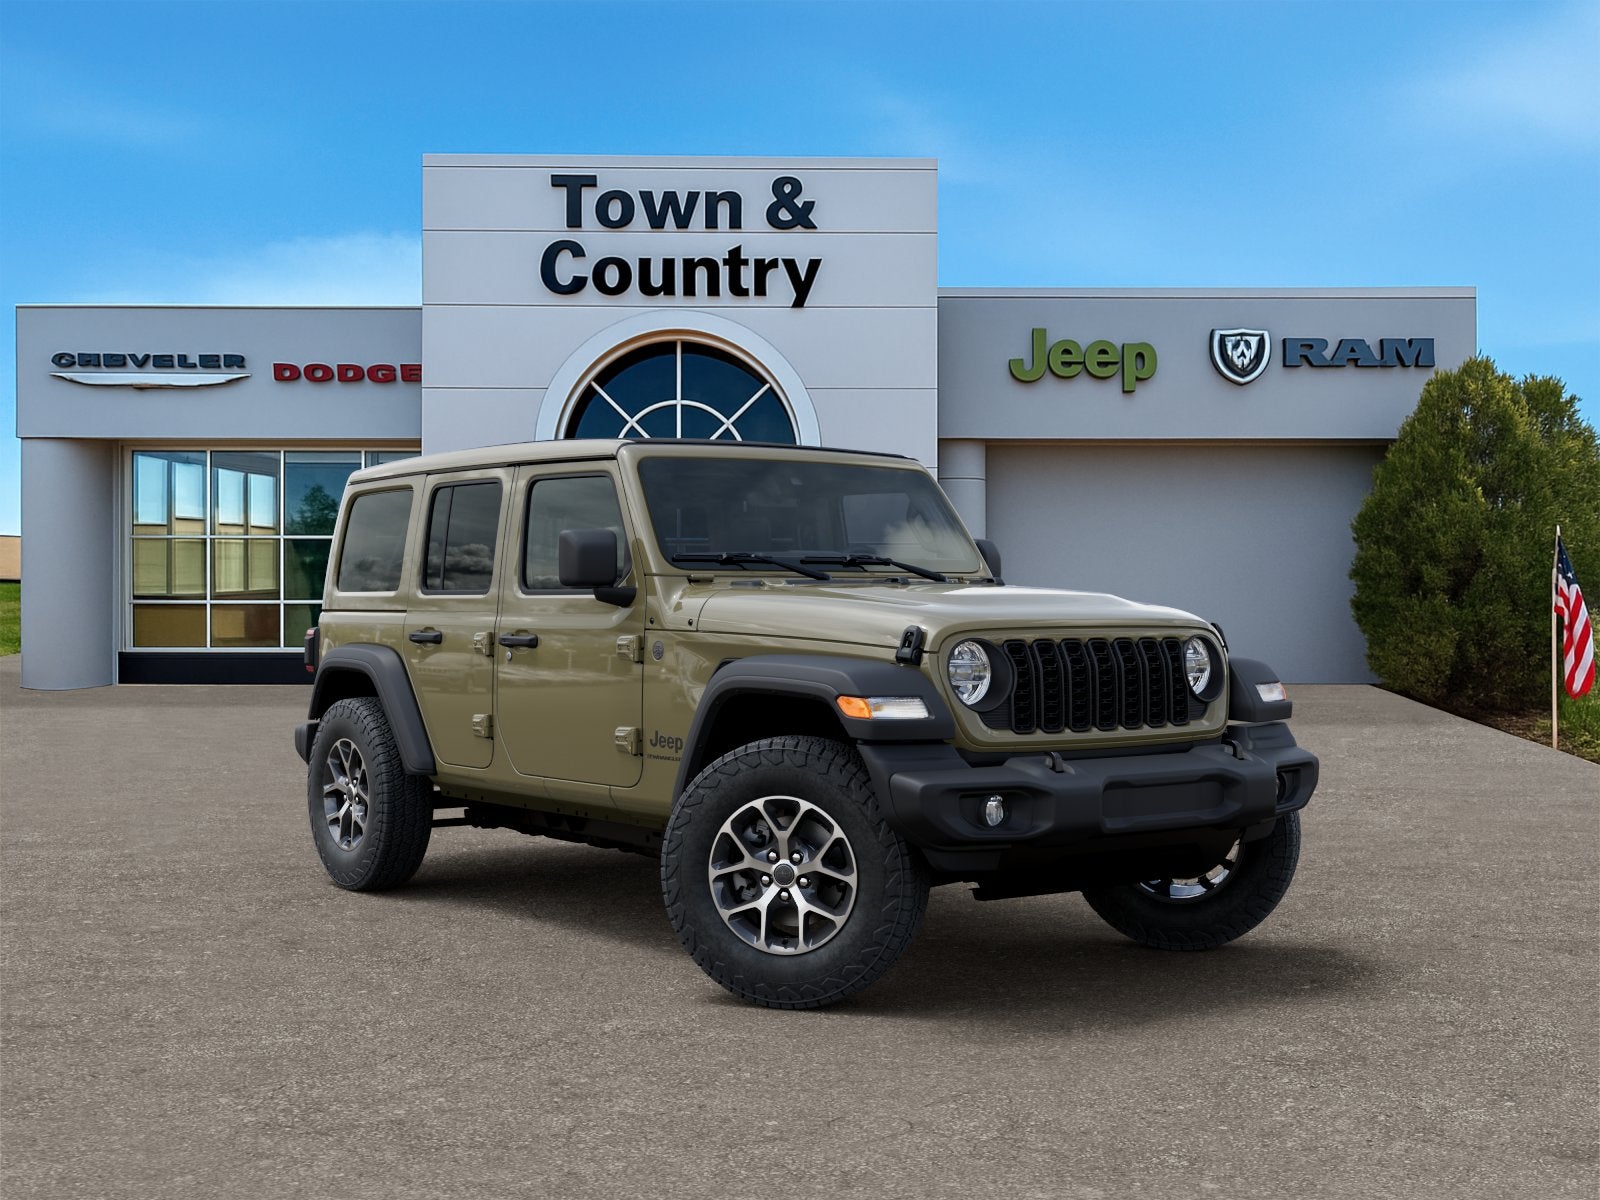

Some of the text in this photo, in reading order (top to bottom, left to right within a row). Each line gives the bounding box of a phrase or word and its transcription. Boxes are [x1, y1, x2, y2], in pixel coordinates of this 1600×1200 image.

[551, 174, 818, 230] Town &
[540, 239, 822, 308] Country
[272, 362, 422, 383] DODGE
[1009, 328, 1158, 393] Jeep
[1282, 337, 1435, 368] RAM
[650, 731, 683, 753] Jeep
